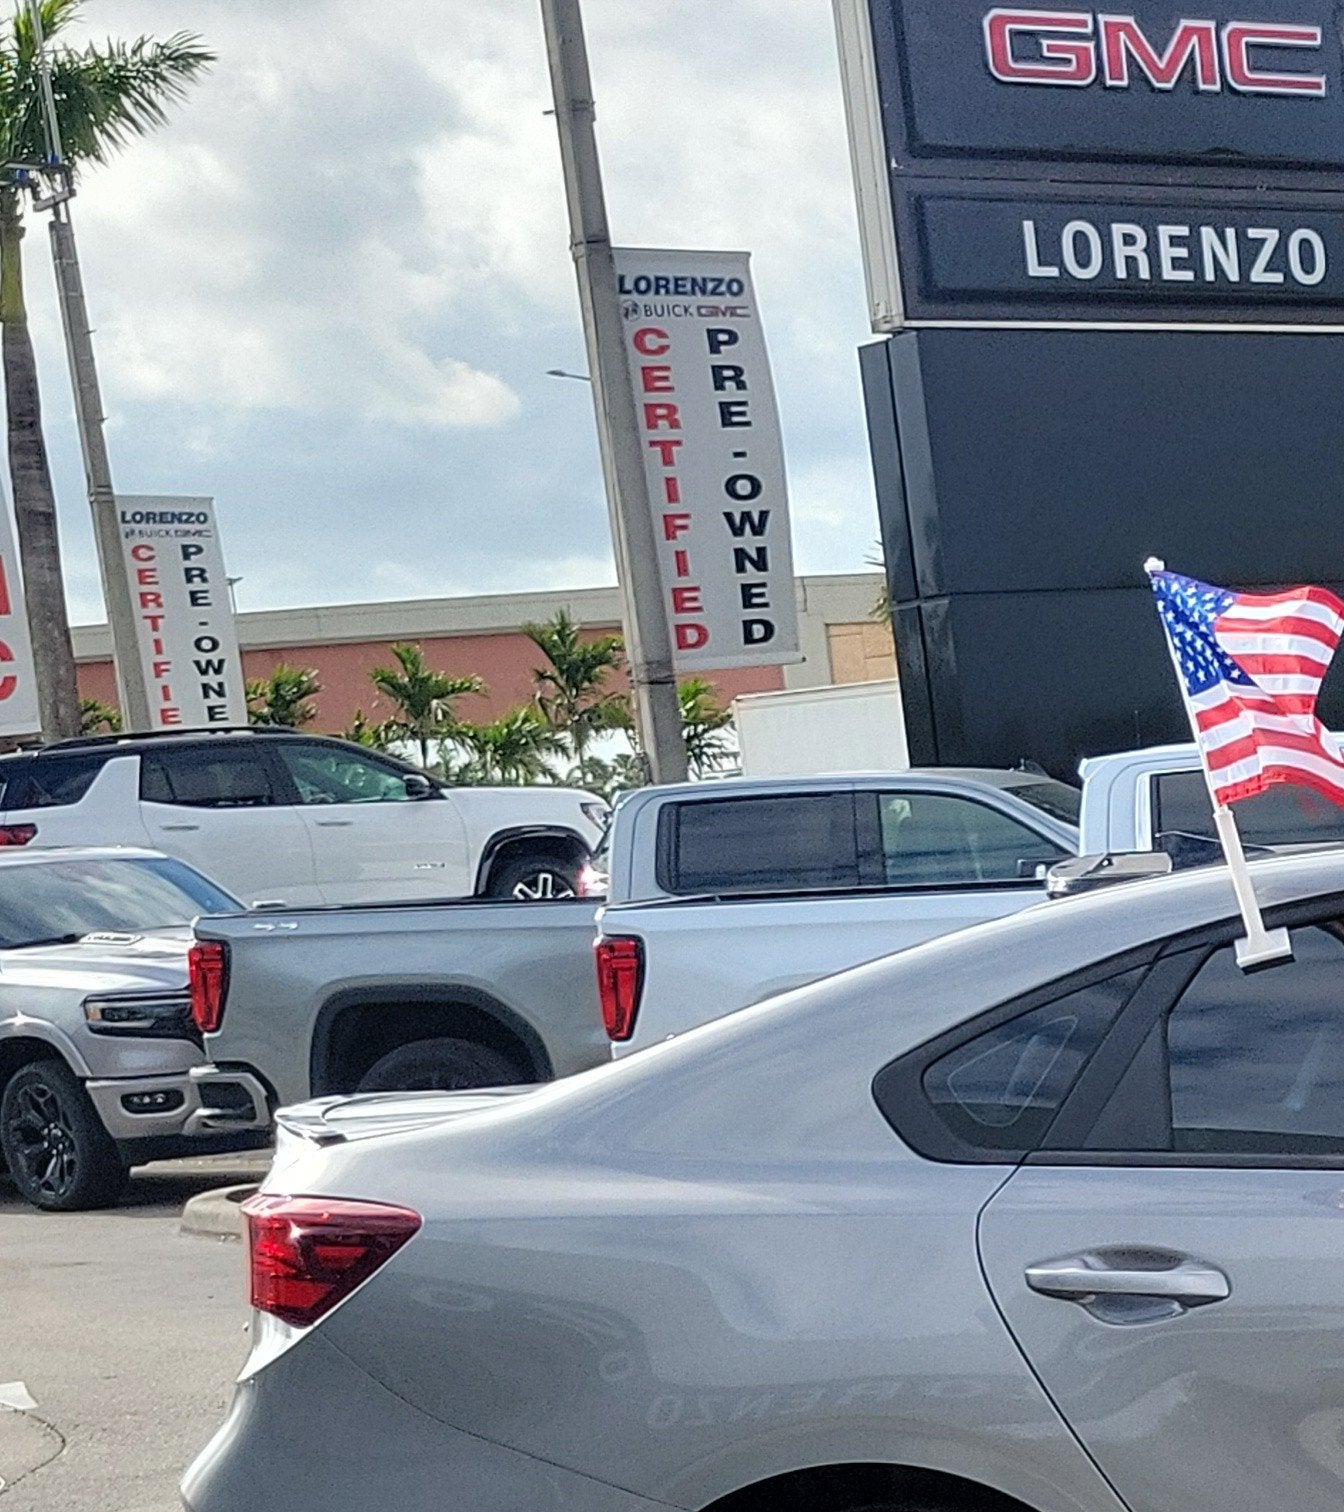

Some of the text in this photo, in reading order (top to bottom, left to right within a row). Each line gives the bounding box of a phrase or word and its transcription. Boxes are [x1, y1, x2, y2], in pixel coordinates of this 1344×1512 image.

[982, 8, 1326, 97] GMC
[617, 273, 745, 297] LORENZO
[1021, 219, 1327, 286] LORENZO
[643, 303, 751, 318] BUICK GMC
[120, 510, 209, 525] LORENZO
[632, 327, 710, 650] CERTIFIED
[705, 327, 776, 646] PRE-OWNED
[138, 529, 173, 539] BUICK
[131, 543, 182, 726] CERTIFIE
[180, 543, 230, 723] PRE-OWNE
